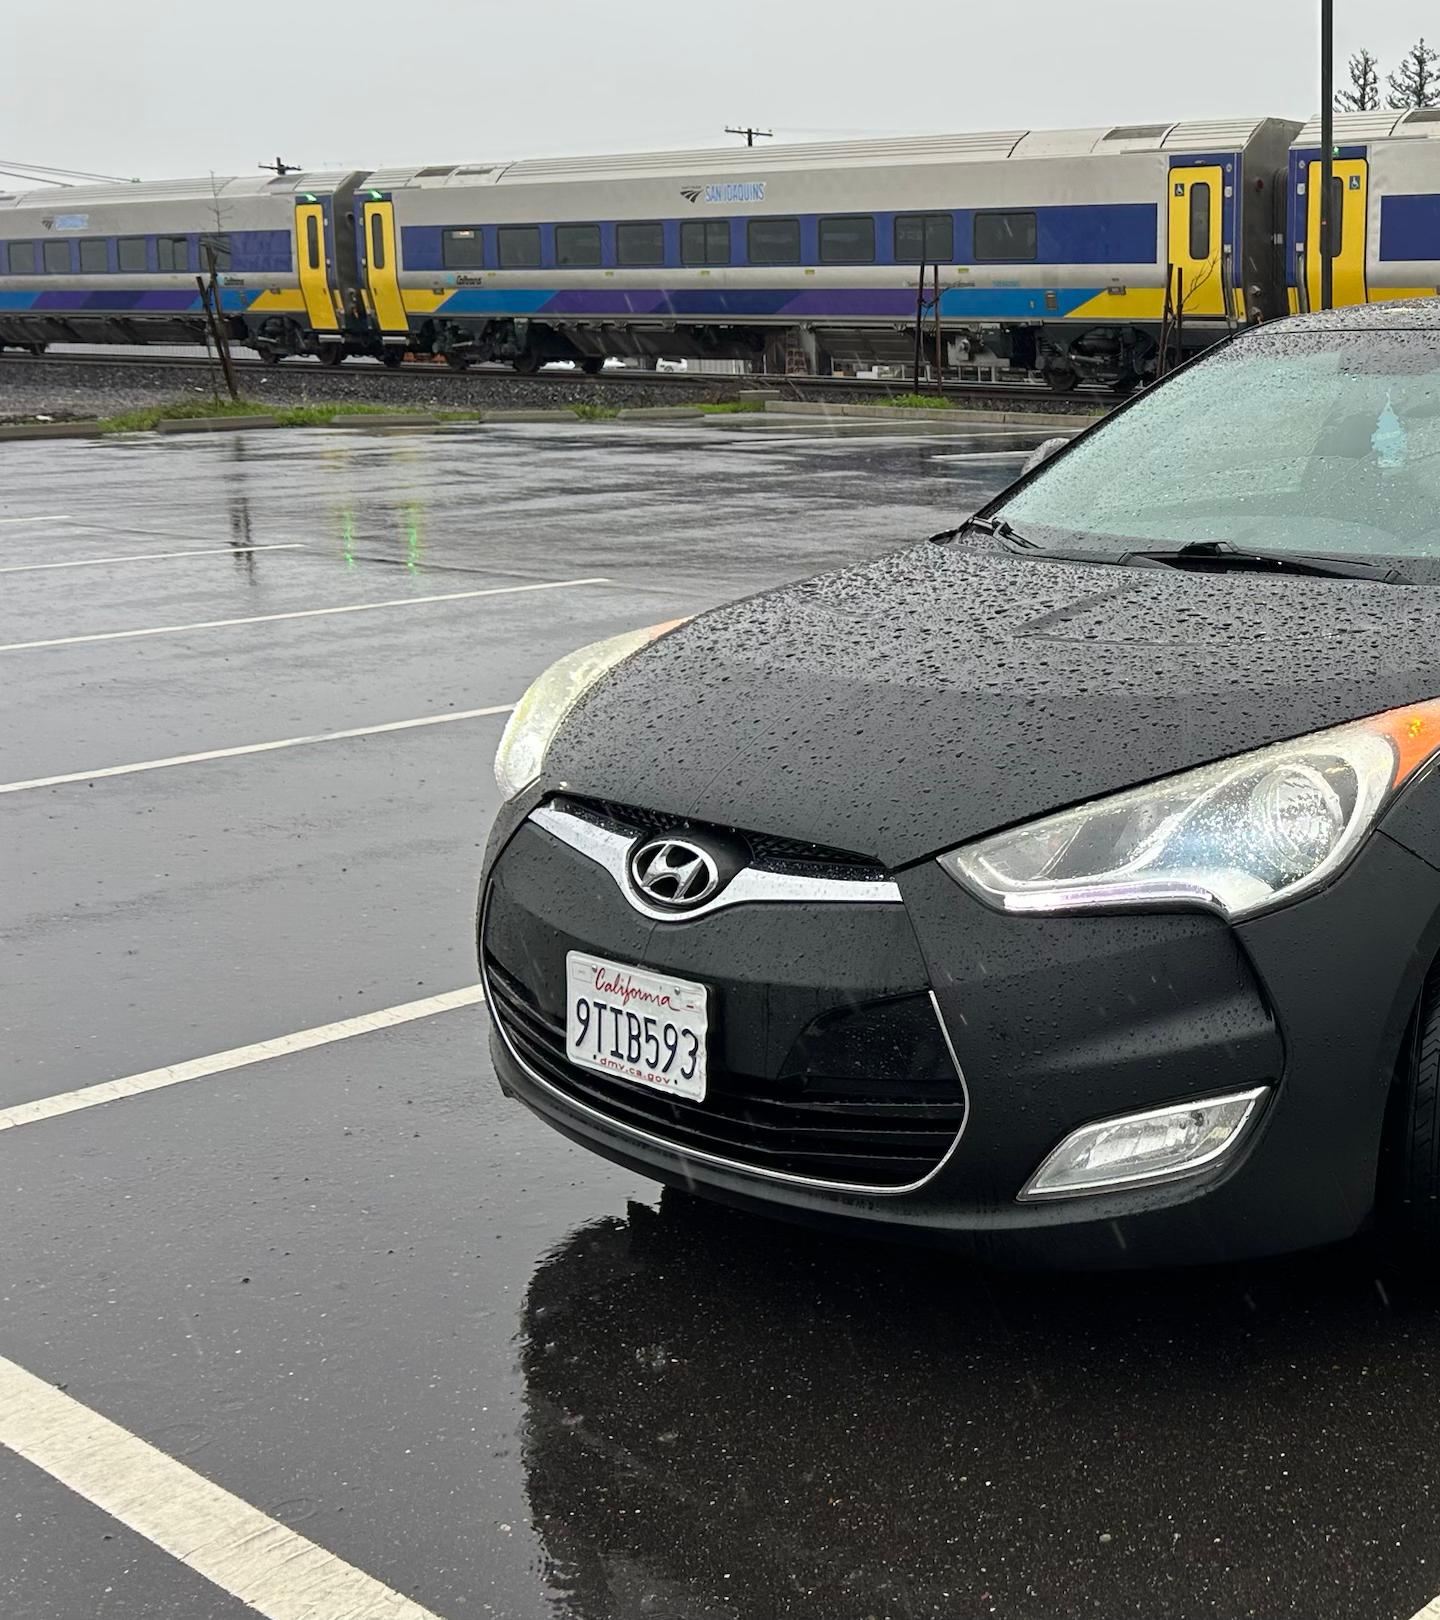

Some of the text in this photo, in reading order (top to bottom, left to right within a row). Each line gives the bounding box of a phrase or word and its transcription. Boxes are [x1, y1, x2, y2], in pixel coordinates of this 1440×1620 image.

[705, 183, 765, 202] SAN JOAQUINS
[595, 967, 681, 1011] California
[575, 998, 699, 1080] 9TIB593
[599, 1057, 671, 1085] dmv.ca.gov
